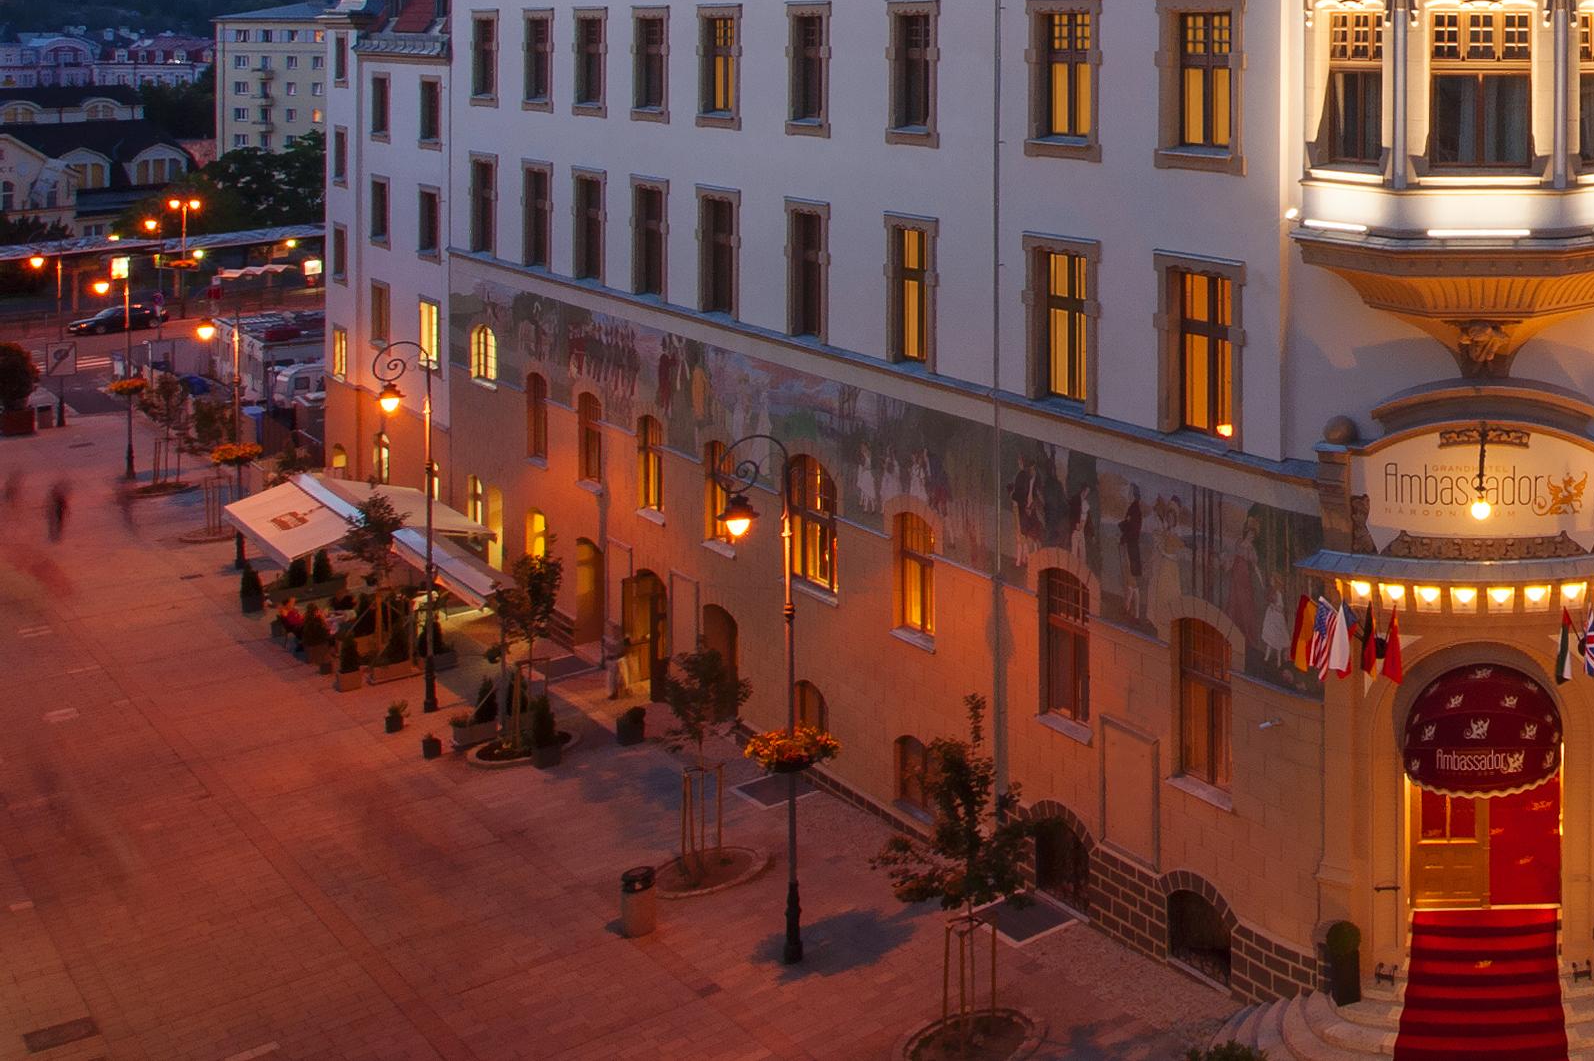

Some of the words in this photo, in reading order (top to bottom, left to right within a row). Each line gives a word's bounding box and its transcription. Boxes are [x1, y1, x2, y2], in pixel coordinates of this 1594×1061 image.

[1431, 464, 1510, 474] GRANDHTEL
[1384, 462, 1544, 506] Ambassador
[1435, 748, 1506, 771] Ambassador
